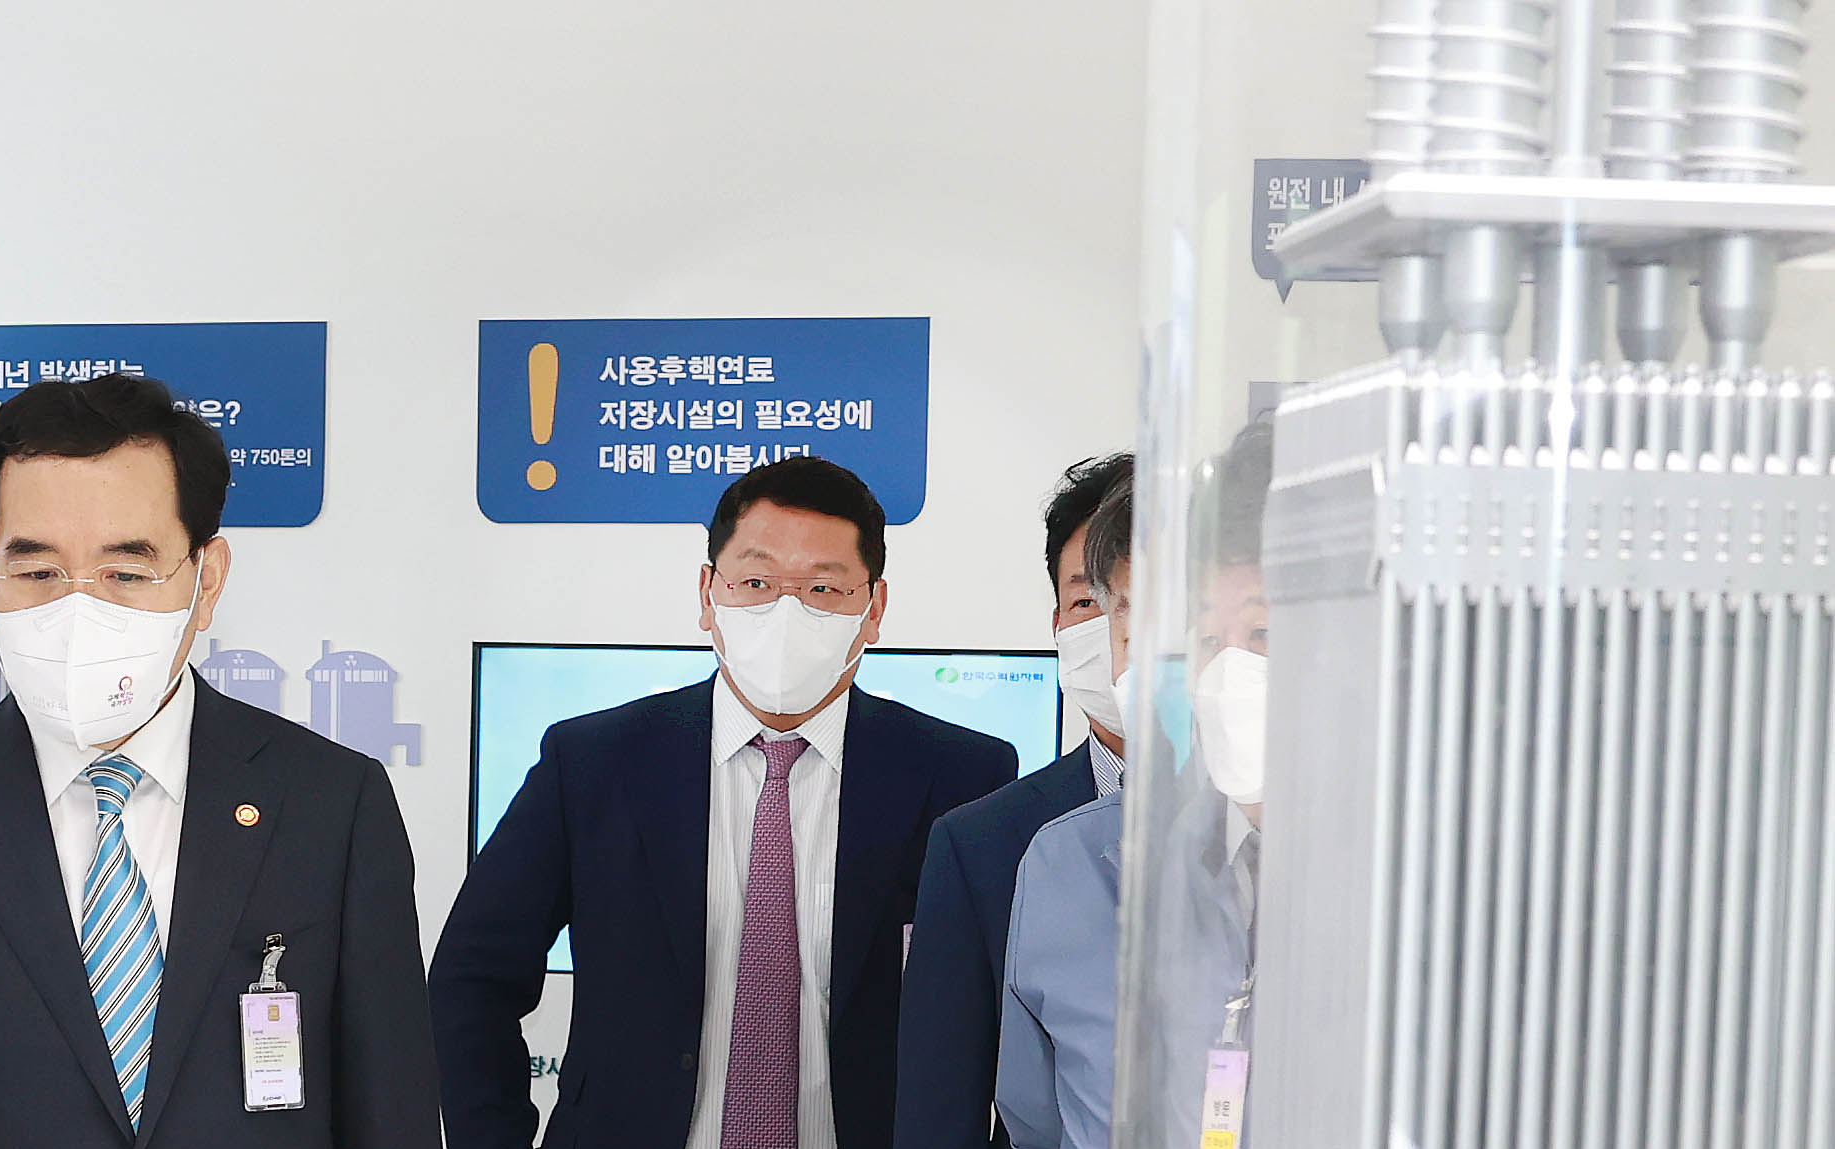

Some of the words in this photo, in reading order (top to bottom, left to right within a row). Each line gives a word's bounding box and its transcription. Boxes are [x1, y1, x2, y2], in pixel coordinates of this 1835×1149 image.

[1267, 177, 1311, 210] 원전
[1321, 177, 1345, 208] 내
[599, 355, 776, 386] 사용후핵연료
[599, 399, 743, 430] 저장시설의
[754, 399, 873, 430] 필요성에
[230, 448, 247, 467] 약
[250, 448, 312, 467] 750톤의
[598, 444, 657, 474] 대해
